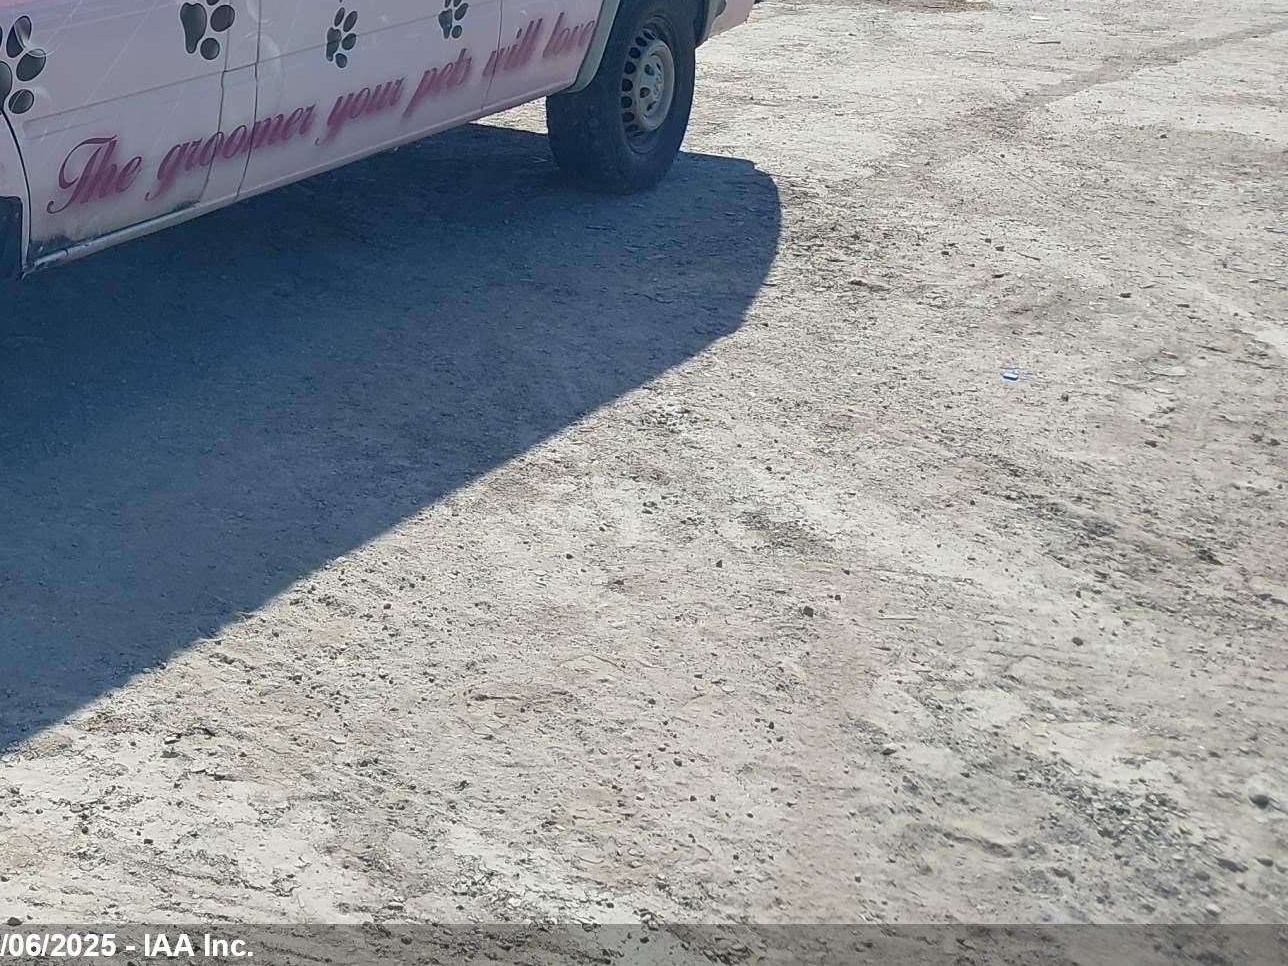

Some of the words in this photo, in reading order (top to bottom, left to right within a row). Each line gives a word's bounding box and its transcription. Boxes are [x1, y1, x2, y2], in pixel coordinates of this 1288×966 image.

[46, 134, 143, 214] The
[144, 102, 316, 202] groomer
[314, 77, 406, 146] your
[402, 47, 474, 119] pets
[480, 17, 544, 78] will
